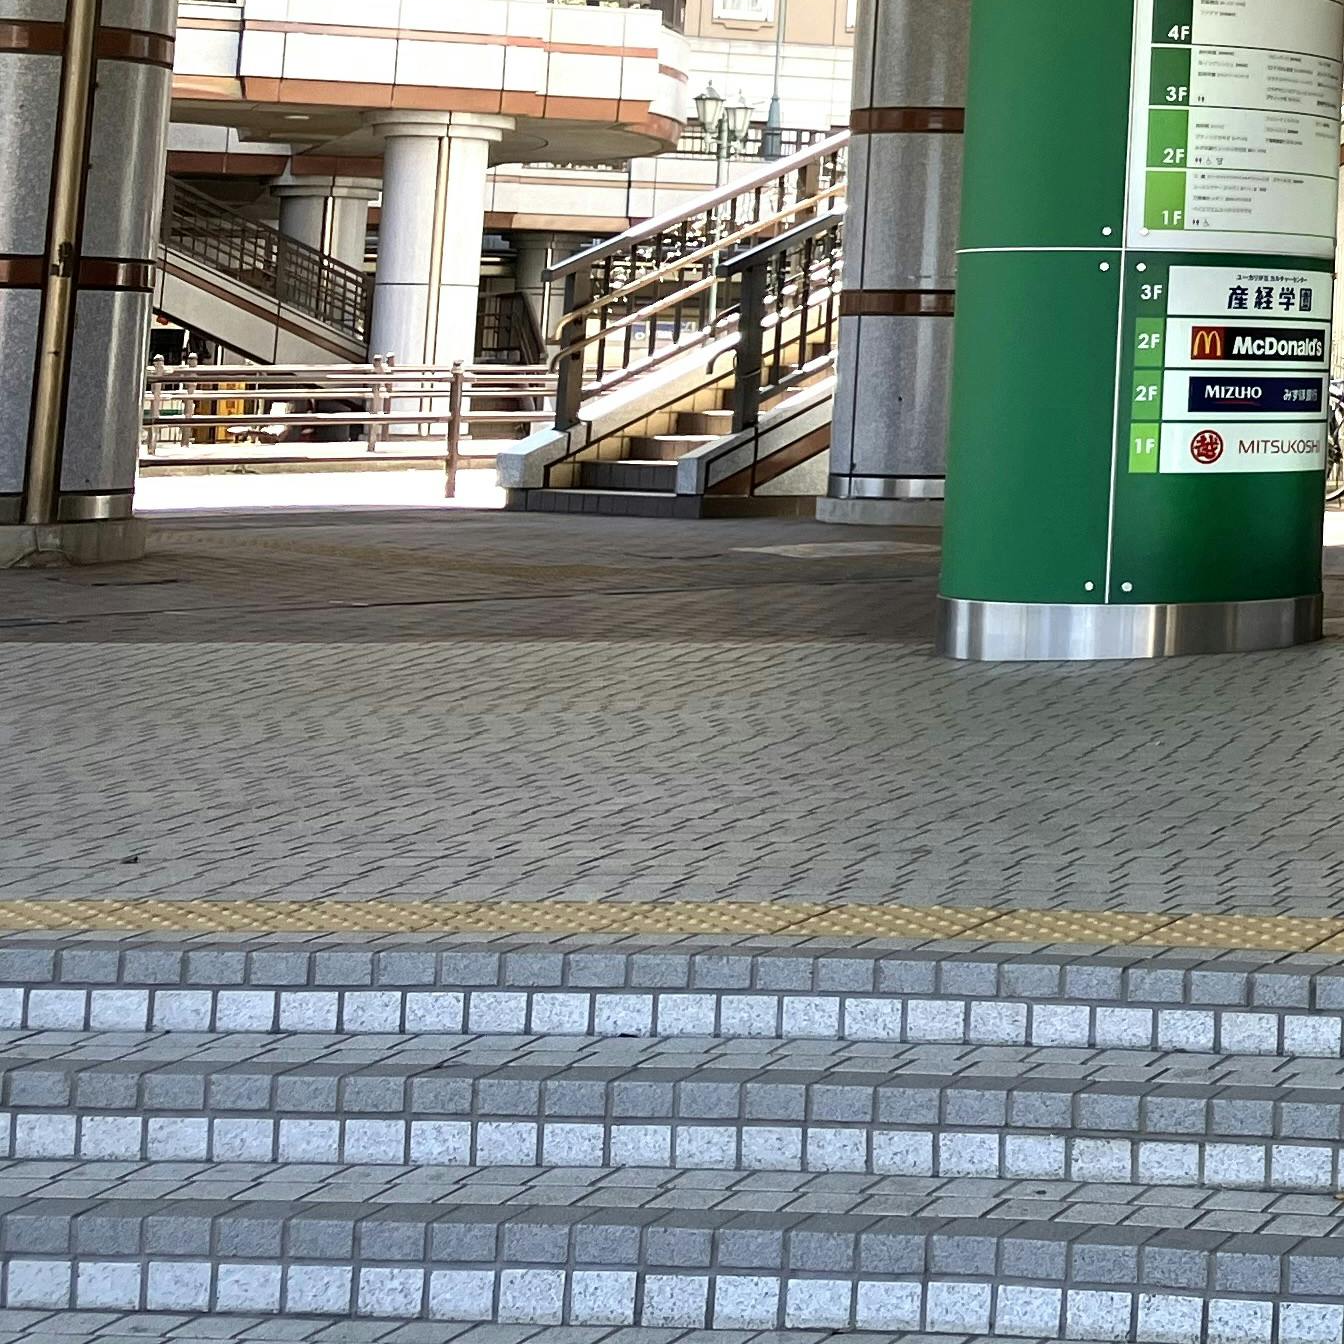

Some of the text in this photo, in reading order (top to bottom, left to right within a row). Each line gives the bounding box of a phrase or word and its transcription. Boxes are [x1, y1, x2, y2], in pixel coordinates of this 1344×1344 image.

[1167, 25, 1190, 41] 4F
[1165, 86, 1188, 102] 3F
[1162, 148, 1185, 164] 2F
[1161, 210, 1183, 225] 1F
[1140, 284, 1163, 300] 3F
[1137, 333, 1160, 349] 2F
[1232, 336, 1322, 356] McDonald's
[1135, 386, 1158, 401] 2F
[1204, 384, 1262, 399] MIZUHO
[1134, 438, 1156, 454] 1F
